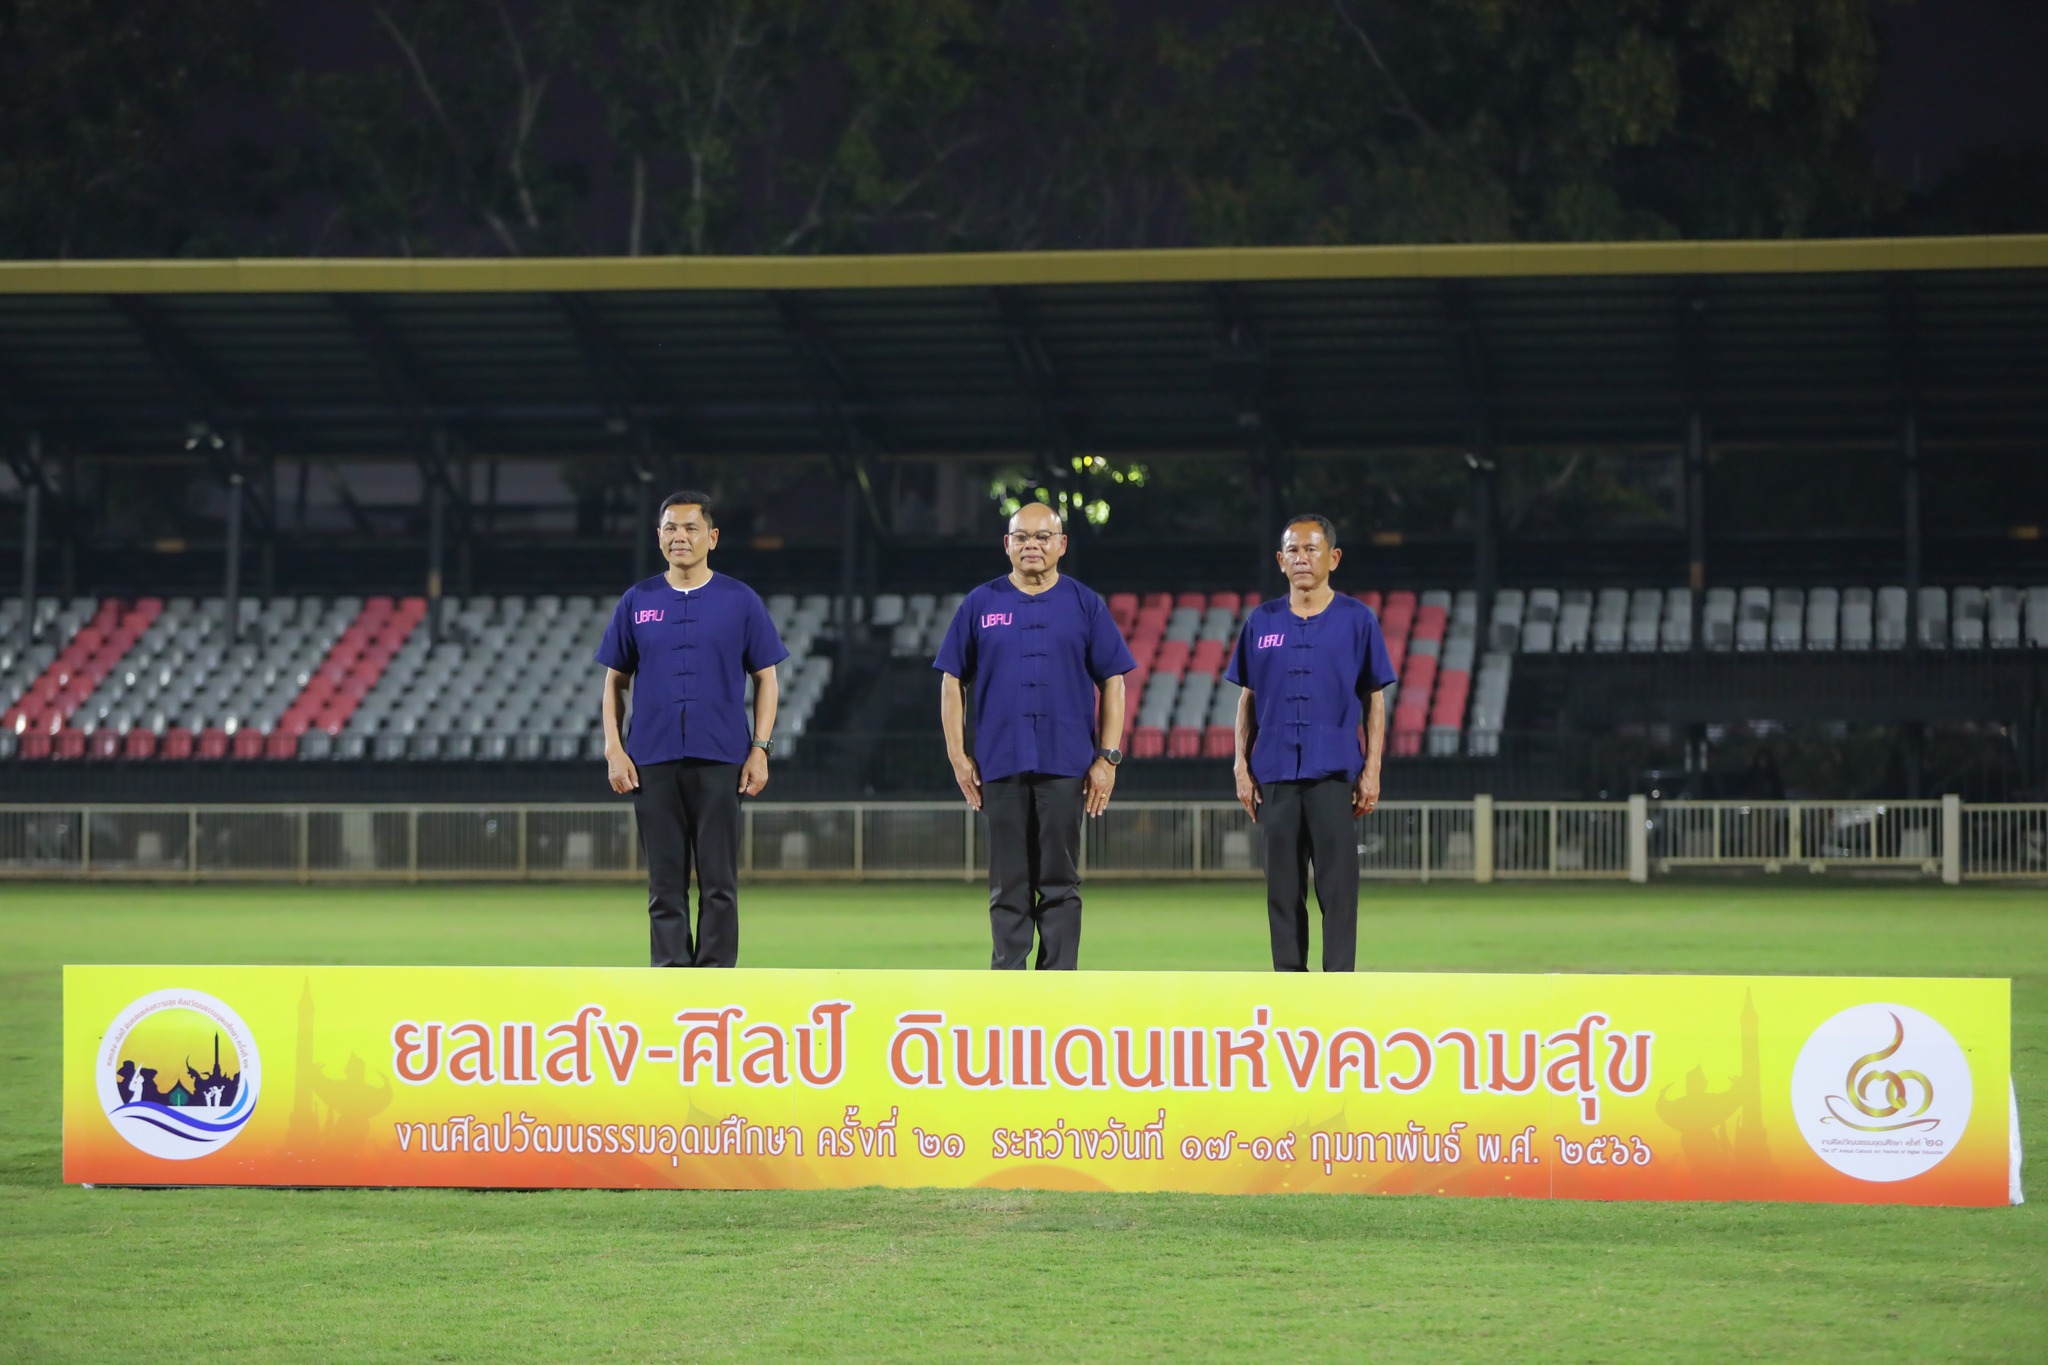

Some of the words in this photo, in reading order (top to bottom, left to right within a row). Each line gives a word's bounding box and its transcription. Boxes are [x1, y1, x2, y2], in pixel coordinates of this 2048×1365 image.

[635, 609, 665, 625] UBRU
[981, 612, 1013, 628] UBRU
[1258, 633, 1285, 649] UBRU
[392, 1001, 854, 1087] ยลแสง-ศิลป์
[888, 1006, 1654, 1123] ดินแดนแห่งความสุข
[395, 1111, 804, 1167] งานศิลปวัฒนธรรมอุดมศึกษา
[817, 1105, 898, 1159] ครั้งที่
[912, 1125, 966, 1159] ๒๑
[991, 1108, 1167, 1162] ระหว่างวันที่
[1180, 1130, 1298, 1164] ๑๗-๑๙
[1311, 1120, 1468, 1176] กุมภาพันธ์
[1478, 1125, 1541, 1165] พ.ศ.
[1554, 1134, 1653, 1166] ๒๕๖๖
